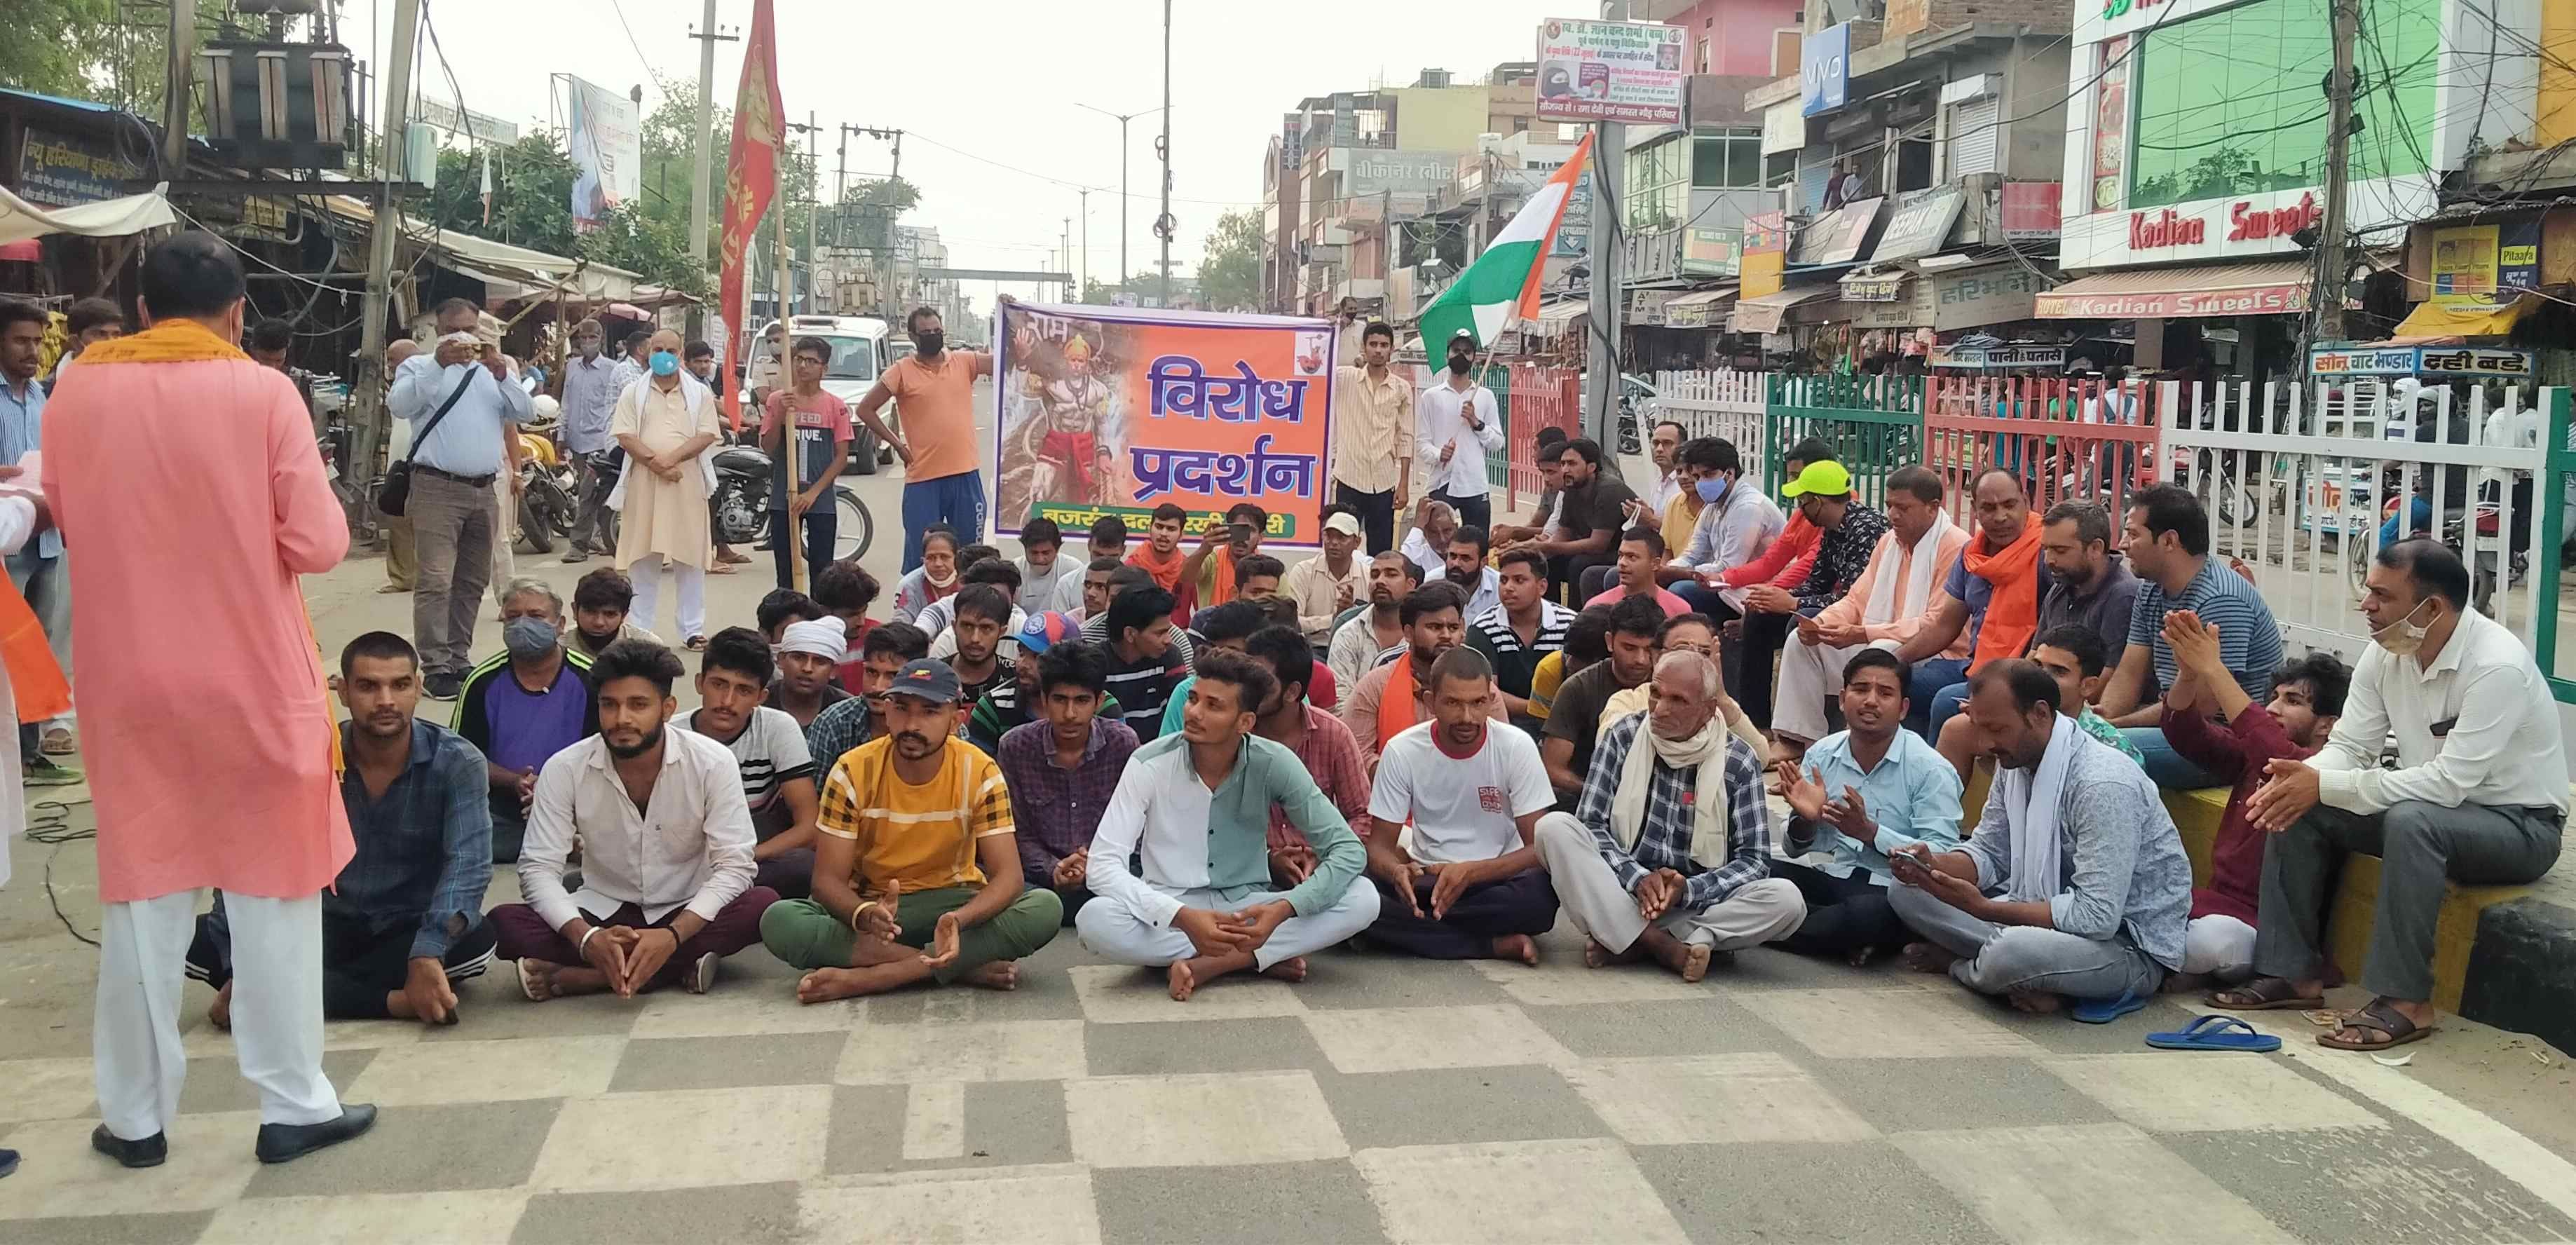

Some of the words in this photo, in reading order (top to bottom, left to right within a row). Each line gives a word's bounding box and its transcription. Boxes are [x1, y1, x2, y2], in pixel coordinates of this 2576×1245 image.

[1806, 55, 1841, 85] vivo
[2128, 208, 2204, 251] Kadian
[2037, 299, 2068, 315] HOTEL
[2080, 294, 2163, 315] Kadian
[2174, 290, 2281, 315] Sweets
[1987, 348, 2020, 362] पानी
[2351, 354, 2374, 369] चाट
[2424, 350, 2473, 370] दही
[1145, 353, 1309, 423] विरोध
[1129, 433, 1319, 502] प्रदर्शन
